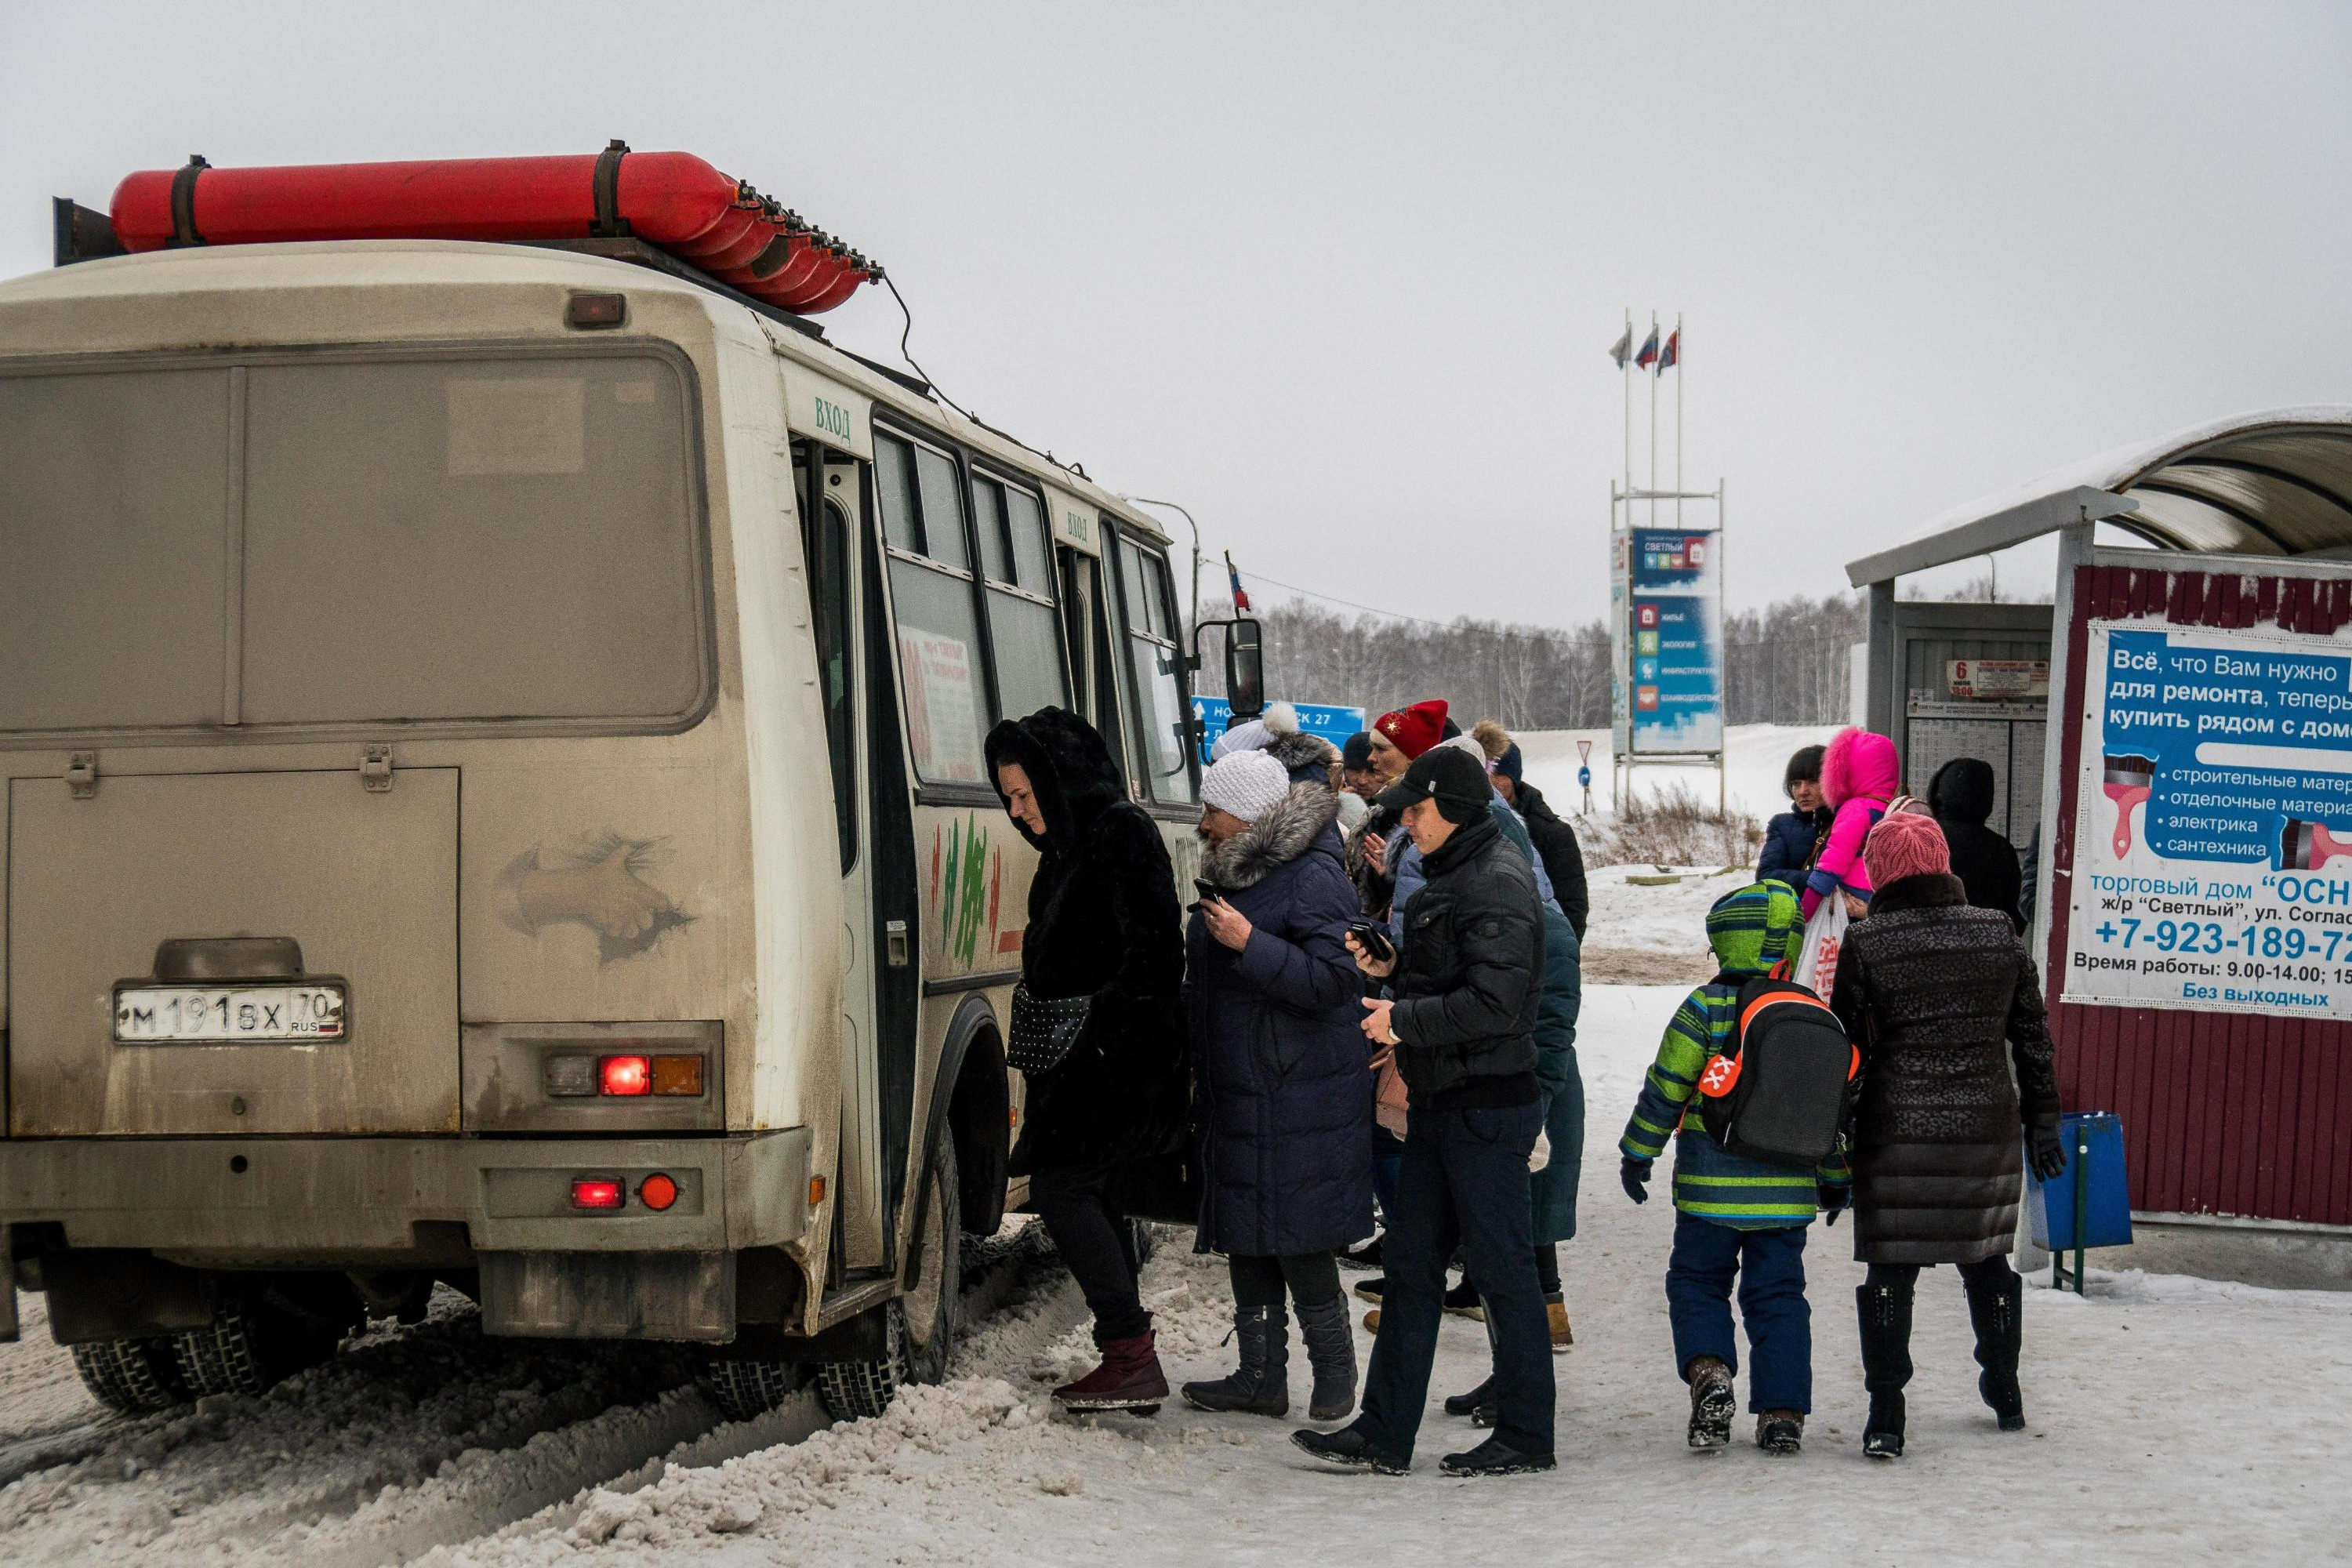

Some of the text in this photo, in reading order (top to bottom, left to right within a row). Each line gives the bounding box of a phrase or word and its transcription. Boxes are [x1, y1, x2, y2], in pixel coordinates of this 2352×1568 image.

[815, 396, 851, 442] ВХОД
[1067, 511, 1087, 543] ВХОД
[1644, 540, 1683, 552] СВЕТЛЫЙ
[2113, 648, 2337, 683] Всё, что Вам нужно
[2110, 681, 2352, 713] для ремонта, теперь
[1315, 713, 1331, 725] 27
[2109, 709, 2352, 739] купить рядом с дом
[2172, 768, 2296, 789] строительные
[2170, 793, 2276, 811] отделочные
[2169, 815, 2257, 833] электрика
[2167, 838, 2267, 857] сантехника
[2091, 875, 2198, 896] торговый
[2205, 882, 2252, 899] дом
[2101, 896, 2133, 913] ж/р
[2255, 907, 2282, 923] ул.
[2074, 952, 2136, 971] Время
[2143, 958, 2220, 977] работы:
[293, 993, 330, 1020] 70
[2183, 982, 2329, 1007] Без выходных
[292, 1022, 318, 1033] RUS
